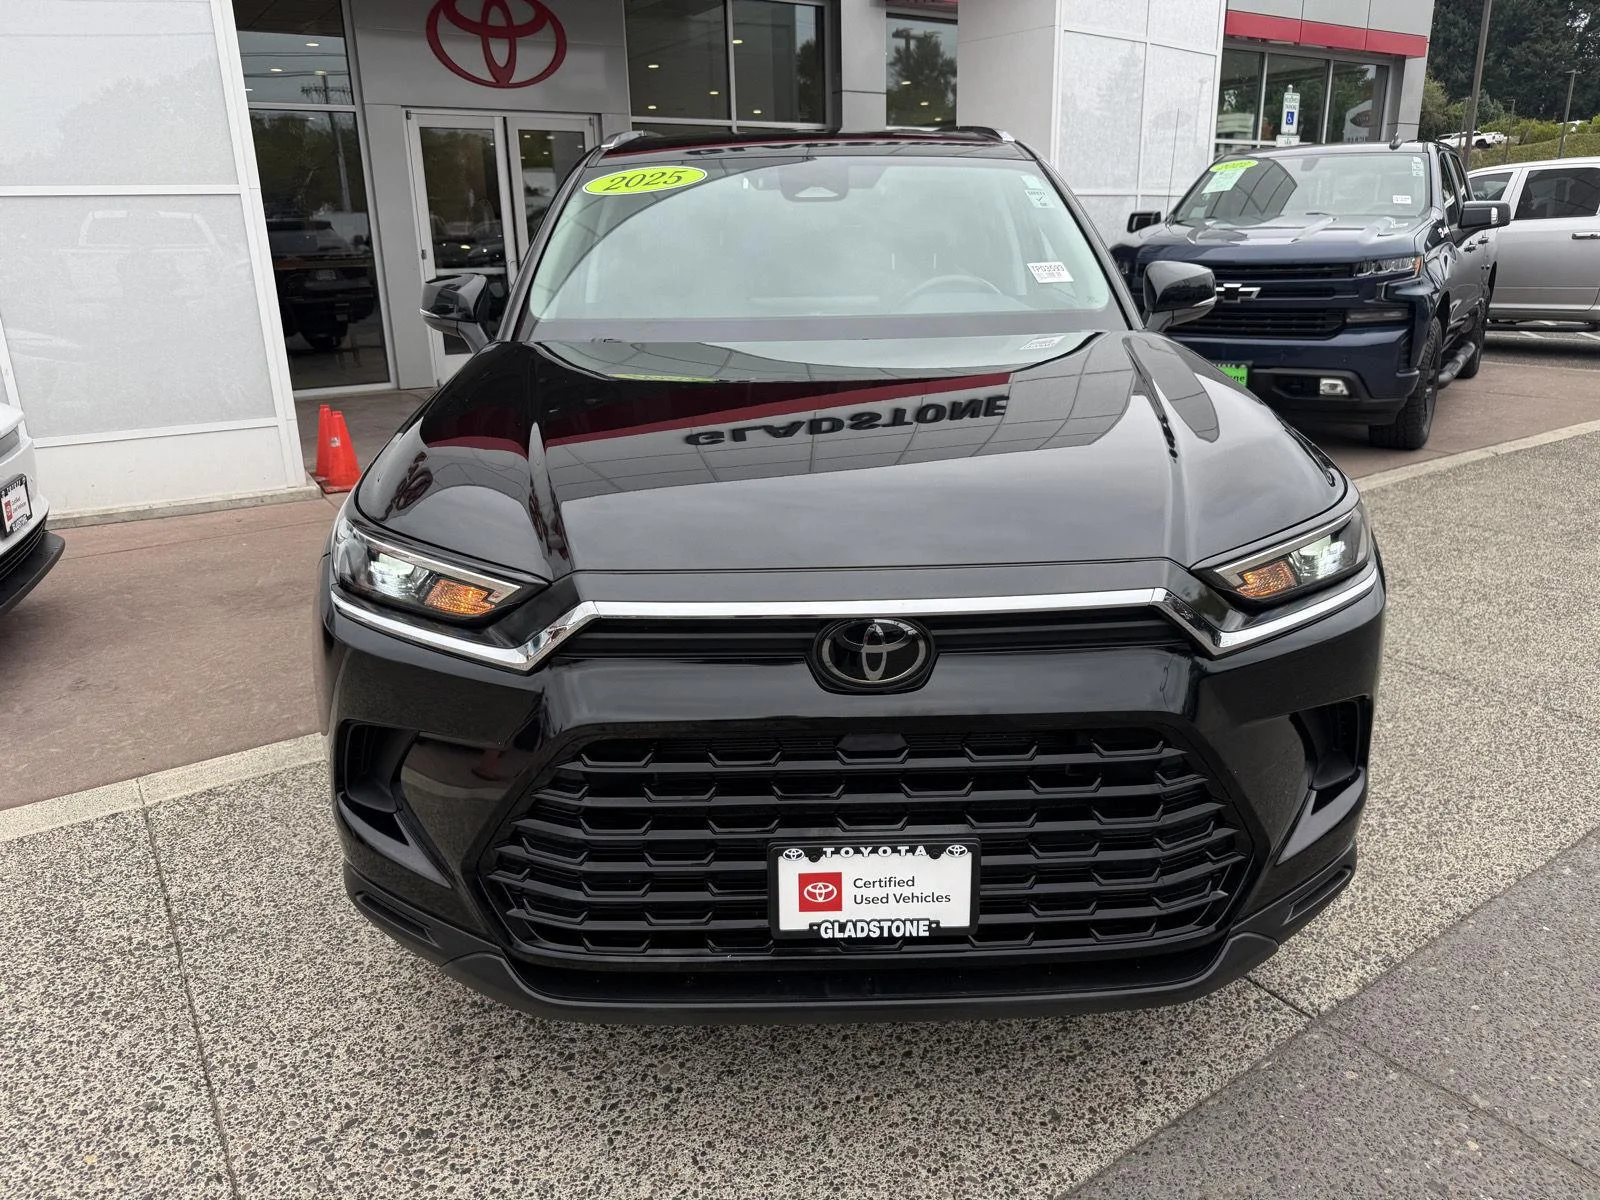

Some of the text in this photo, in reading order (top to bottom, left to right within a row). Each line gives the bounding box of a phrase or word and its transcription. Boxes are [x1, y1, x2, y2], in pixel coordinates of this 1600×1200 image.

[603, 170, 687, 191] 2025
[823, 845, 927, 858] TOYOTA
[853, 876, 915, 889] Certified
[853, 892, 951, 905] Used Vehicles
[820, 920, 930, 938] GLADSTONE
